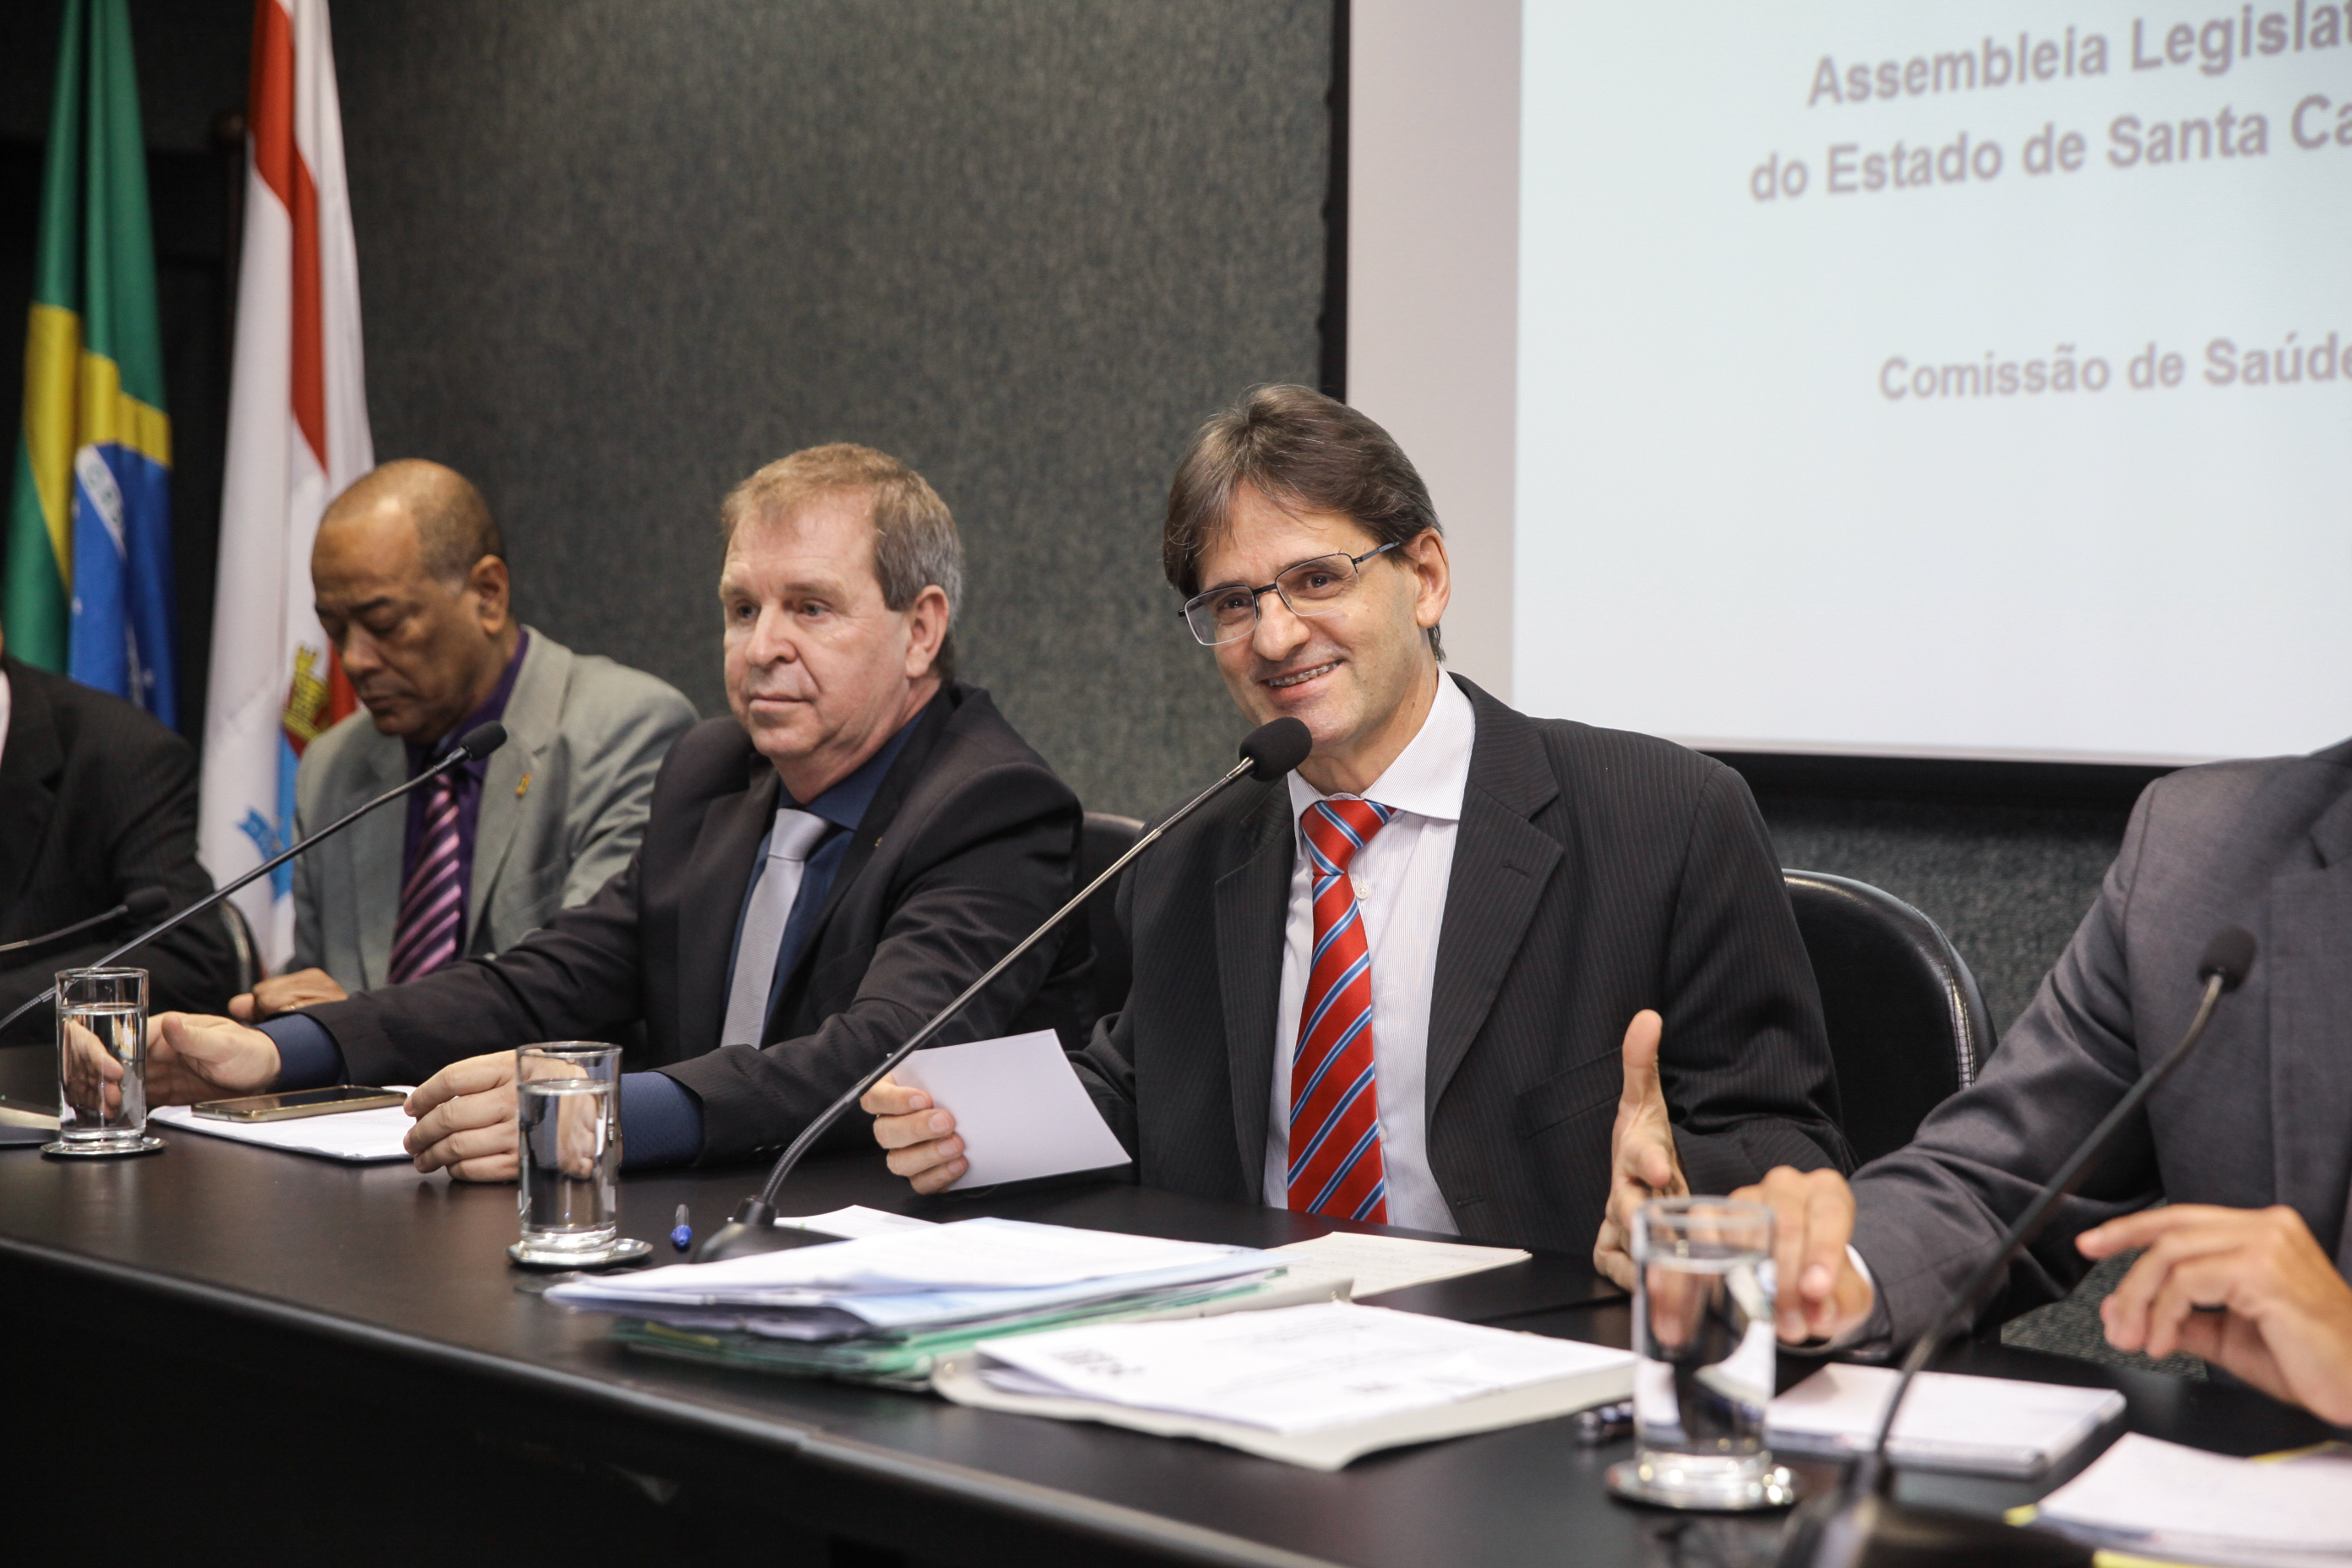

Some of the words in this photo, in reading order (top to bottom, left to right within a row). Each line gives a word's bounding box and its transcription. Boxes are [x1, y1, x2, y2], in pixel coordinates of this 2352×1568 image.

[1805, 24, 2110, 108] Assembleia
[1749, 150, 1810, 204] do
[1826, 130, 2005, 196] Estado
[2021, 121, 2088, 177] de
[2106, 103, 2270, 170] Santa
[1878, 341, 2112, 402] Comissão
[2126, 340, 2186, 391] de
